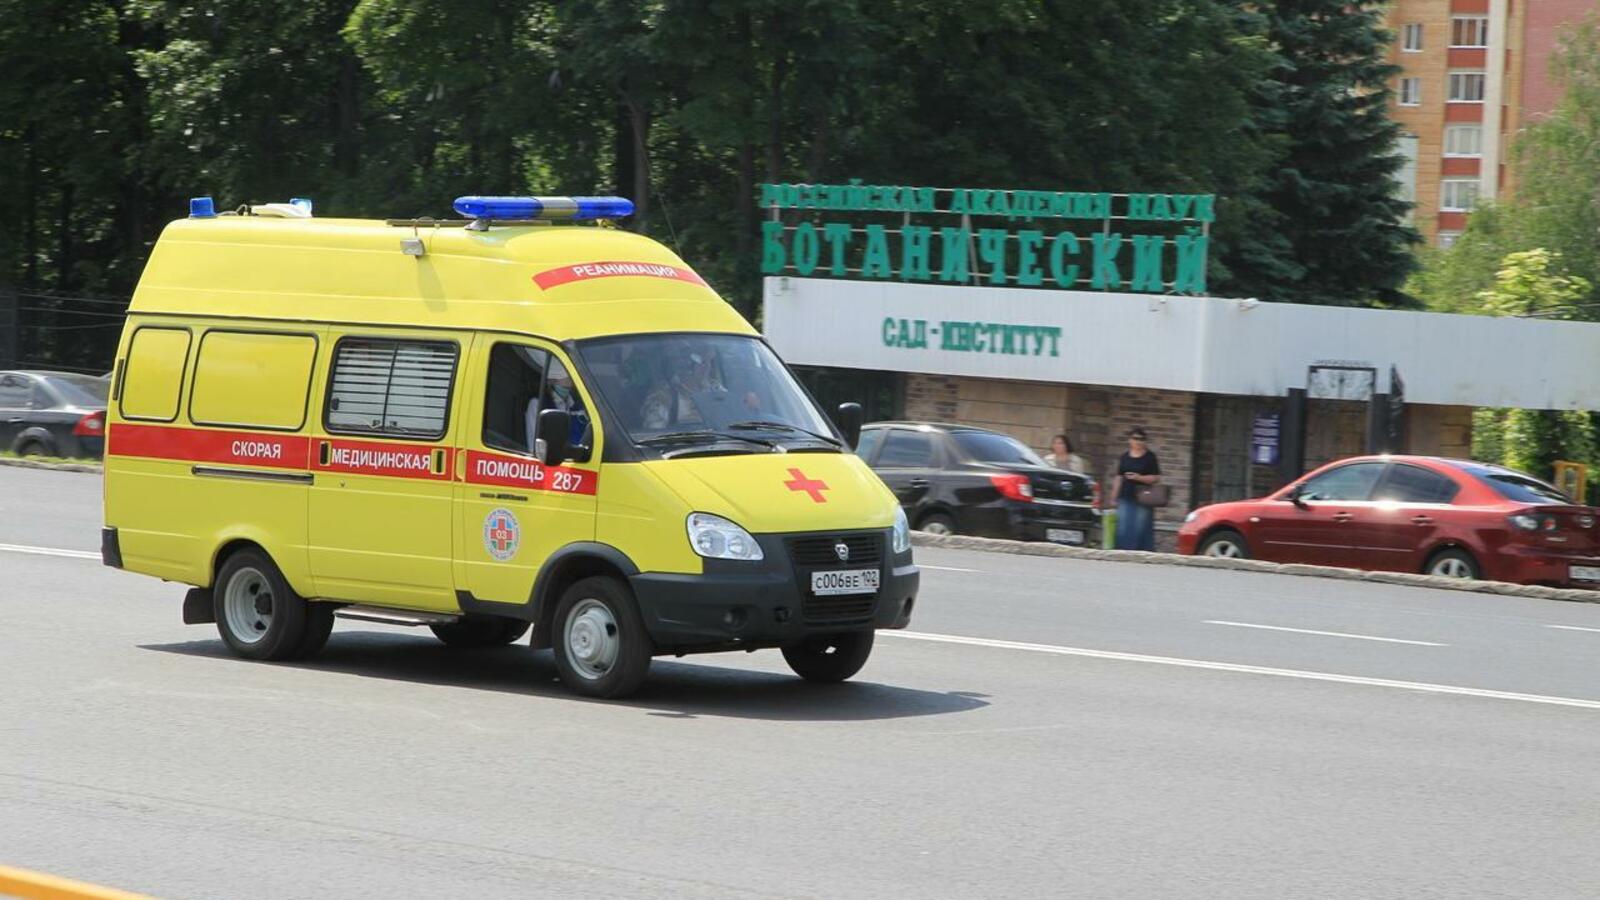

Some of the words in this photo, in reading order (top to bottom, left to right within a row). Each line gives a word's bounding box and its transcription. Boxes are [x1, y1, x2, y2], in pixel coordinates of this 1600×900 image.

[761, 178, 935, 212] РОССИЙСКАЯ
[950, 188, 1112, 222] АКАДЕМИЯ
[1128, 193, 1215, 223] НАУК
[572, 263, 677, 277] РЕАНИМАЦИЯ
[761, 221, 1208, 297] БОТАНИЧЕСКИЙ
[231, 440, 282, 460] СКОРАЯ
[331, 447, 431, 471] МЕДИЦИНСКАЯ
[476, 459, 544, 482] ПОМОЩЬ
[552, 471, 582, 492] 287
